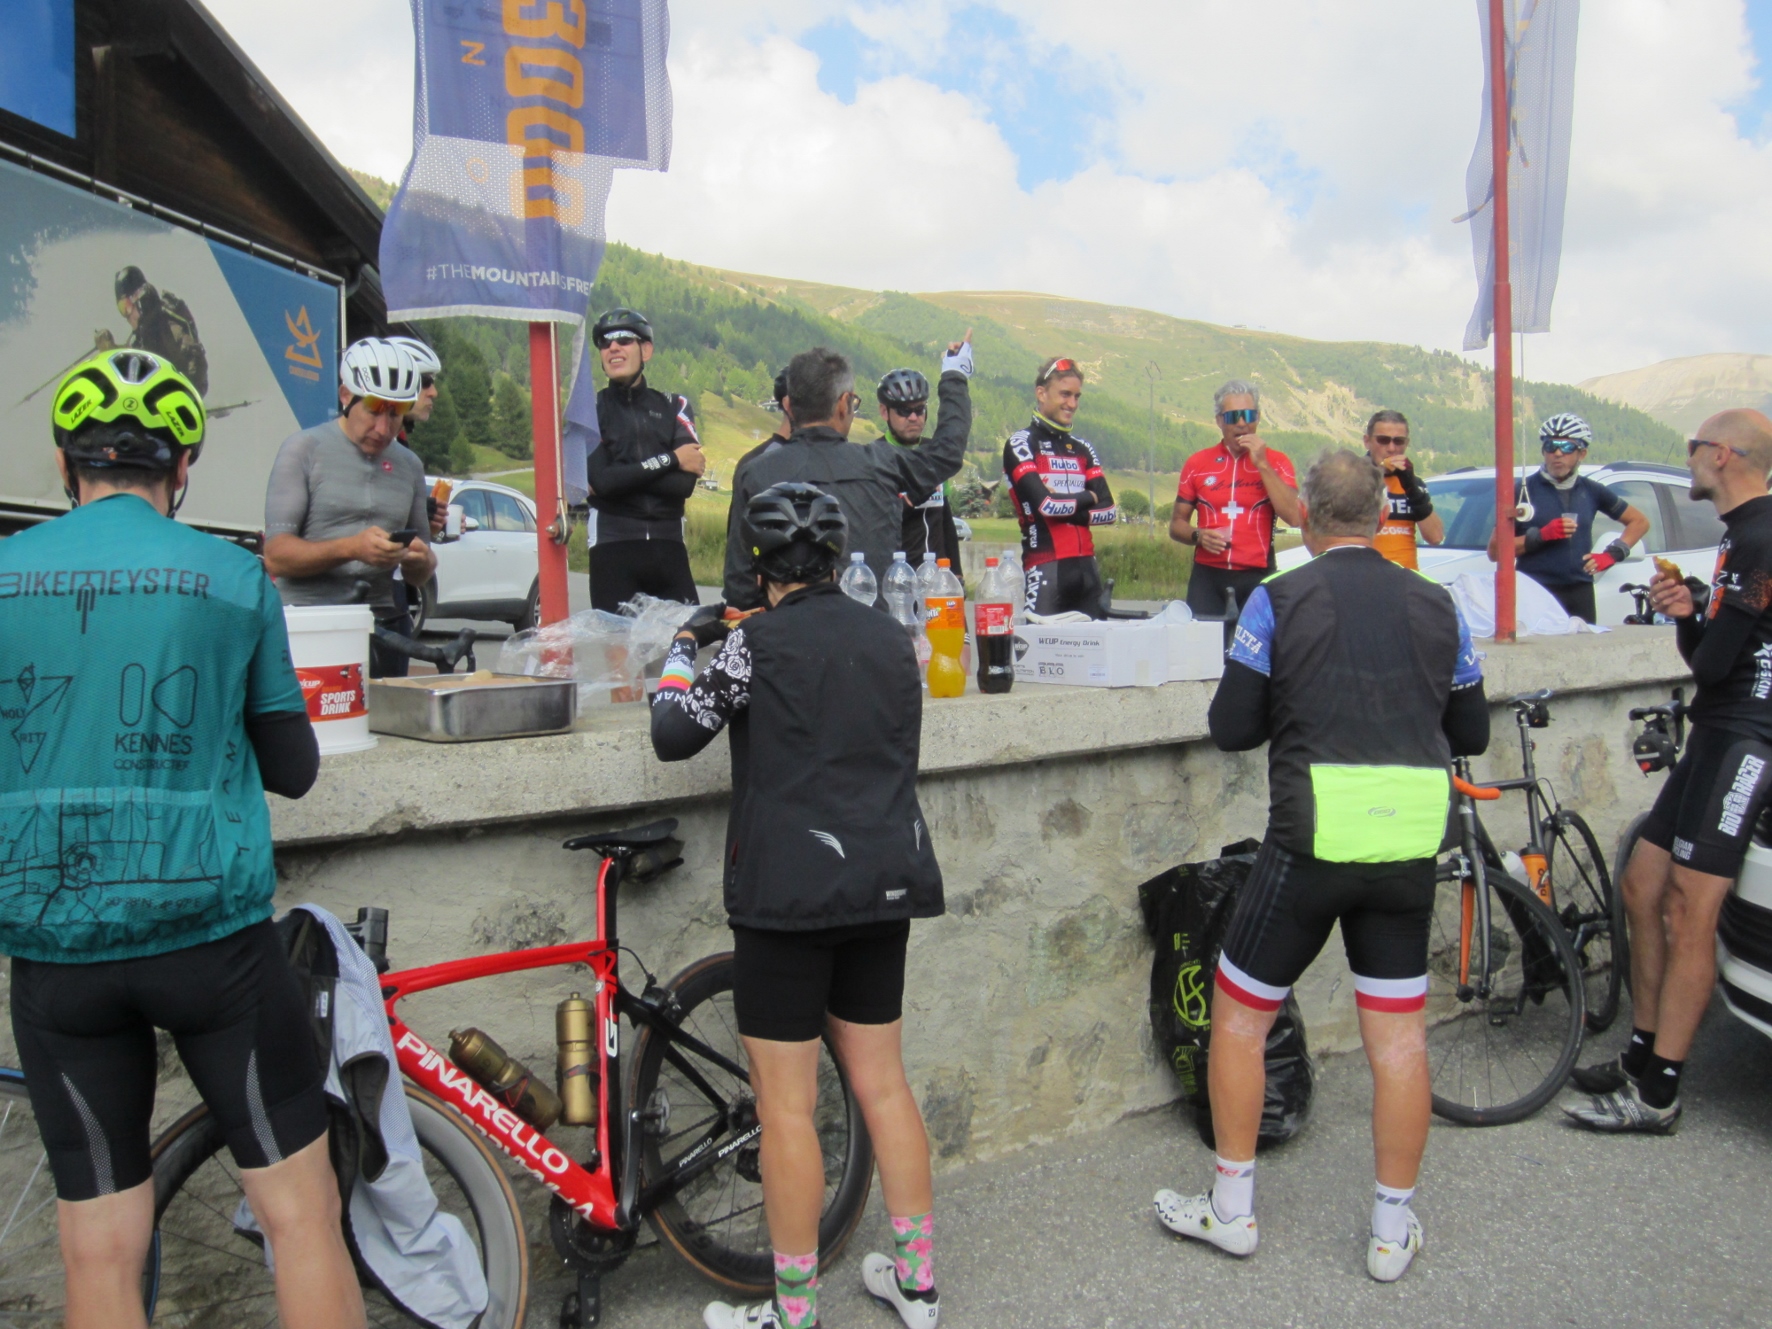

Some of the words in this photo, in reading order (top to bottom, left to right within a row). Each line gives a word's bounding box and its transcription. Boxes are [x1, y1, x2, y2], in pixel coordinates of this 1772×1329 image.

[70, 399, 92, 424] LAZER
[166, 411, 185, 437] LAZER
[1051, 459, 1078, 470] Hubo
[1042, 501, 1074, 514] Hubo
[1060, 638, 1081, 647] Energy
[1083, 639, 1100, 647] Drink
[320, 690, 356, 704] SPORTS
[320, 702, 351, 715] DRINK
[114, 732, 193, 755] KENNES
[397, 1031, 571, 1175] PINARELLO
[679, 1137, 713, 1168] PINARELLO
